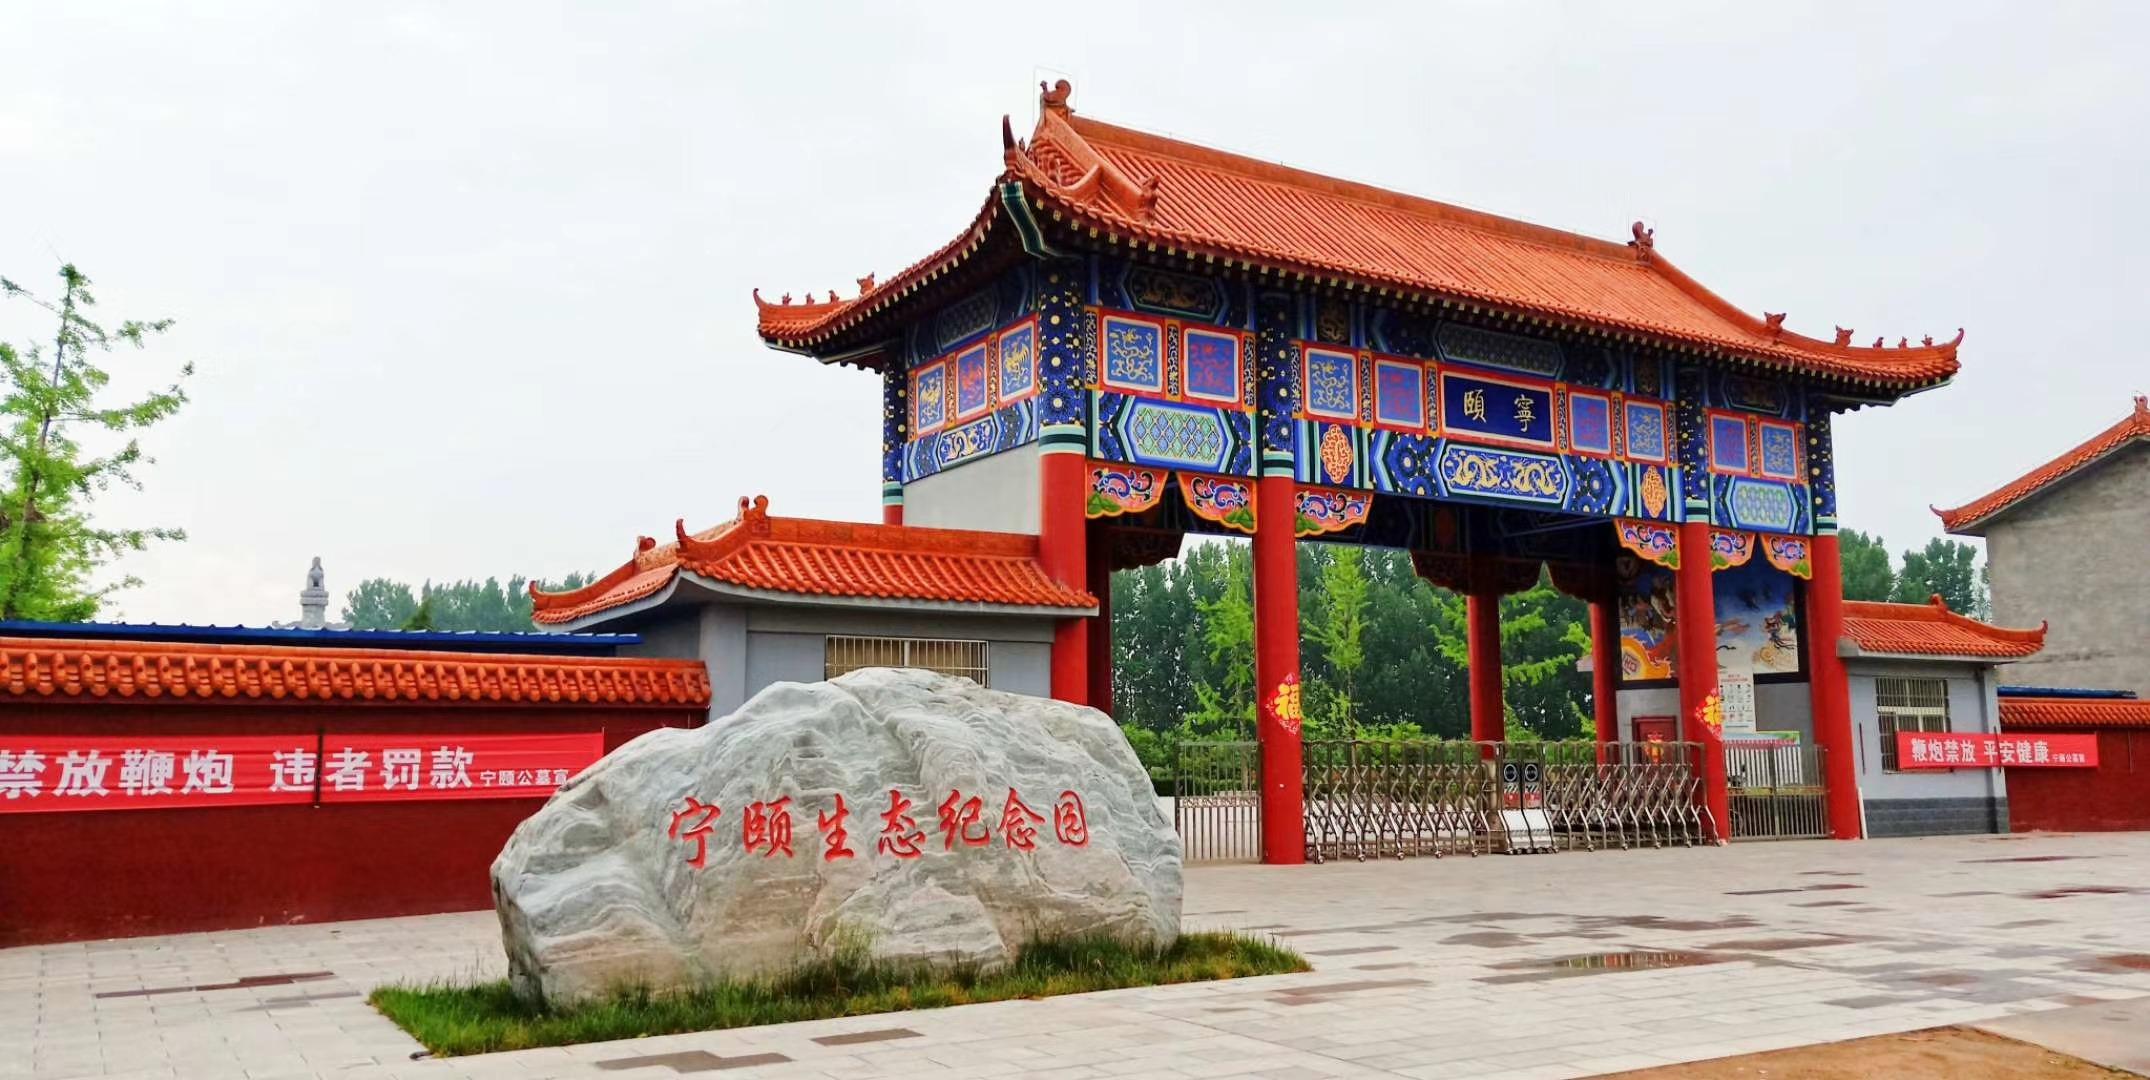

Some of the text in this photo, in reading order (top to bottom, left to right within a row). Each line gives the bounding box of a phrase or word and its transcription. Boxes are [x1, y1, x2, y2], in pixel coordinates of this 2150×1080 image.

[0, 748, 235, 799] 禁放鞭炮
[269, 745, 475, 793] 违者罚款
[1911, 738, 1977, 763] 鞭炮禁放
[1983, 740, 2050, 764] 平安健康
[668, 787, 1089, 869] 宁颐生态纪念园
